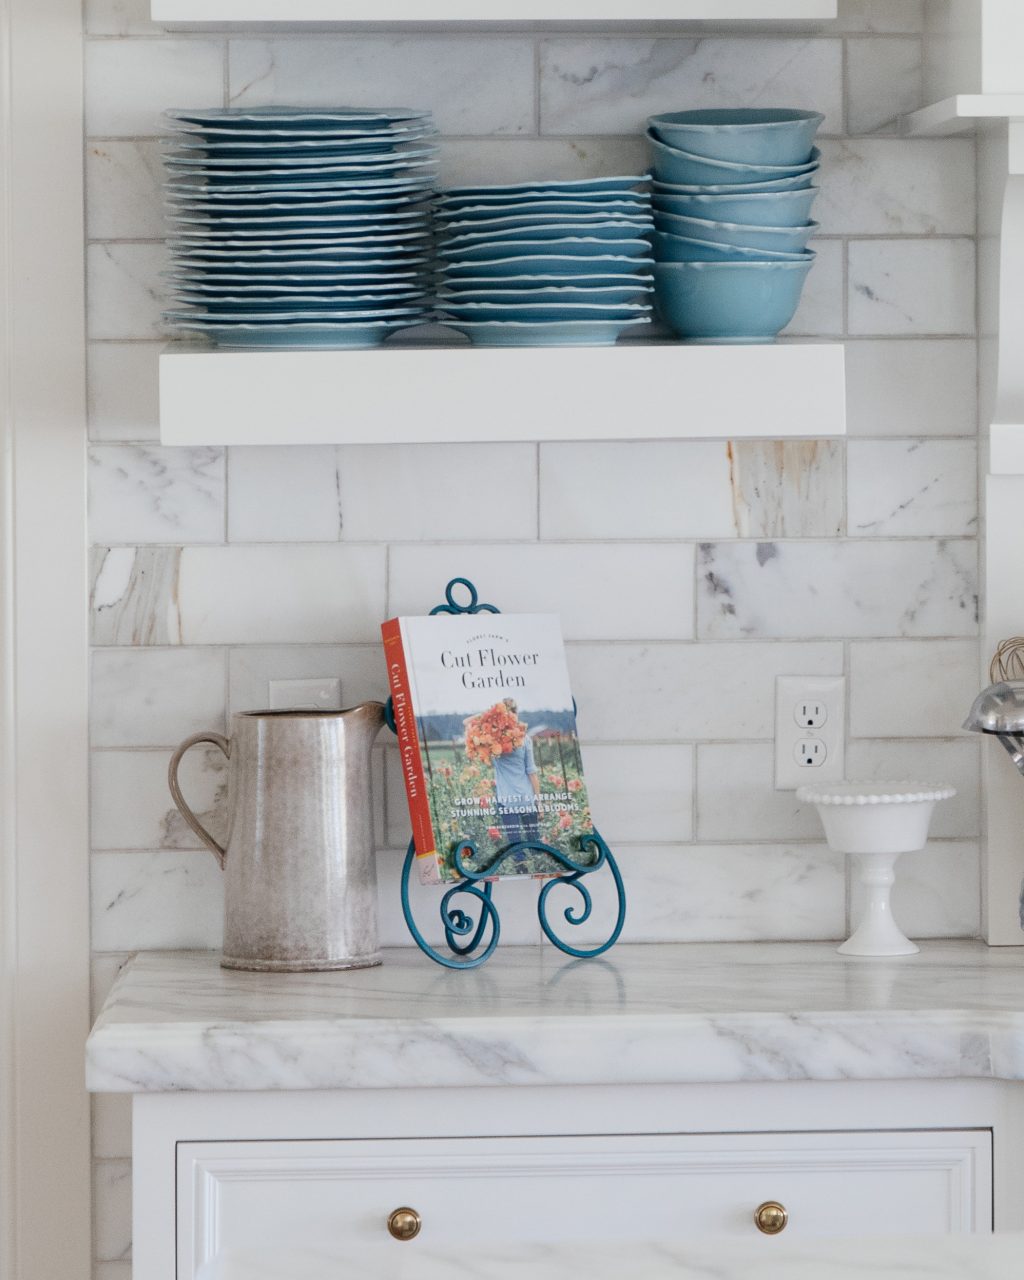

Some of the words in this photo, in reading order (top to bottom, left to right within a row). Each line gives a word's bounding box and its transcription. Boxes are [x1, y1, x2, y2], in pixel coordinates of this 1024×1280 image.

[440, 650, 471, 669] Cut
[478, 648, 539, 667] Flower
[391, 662, 402, 689] Cut
[461, 669, 526, 689] Garden
[395, 692, 410, 742] Flower
[404, 745, 418, 798] Garden
[485, 795, 523, 804] HARVEST
[533, 792, 573, 801] ARRANGE
[450, 808, 496, 818] STUNNING
[499, 805, 544, 815] SEASONAL
[544, 803, 580, 812] BLOOMS
